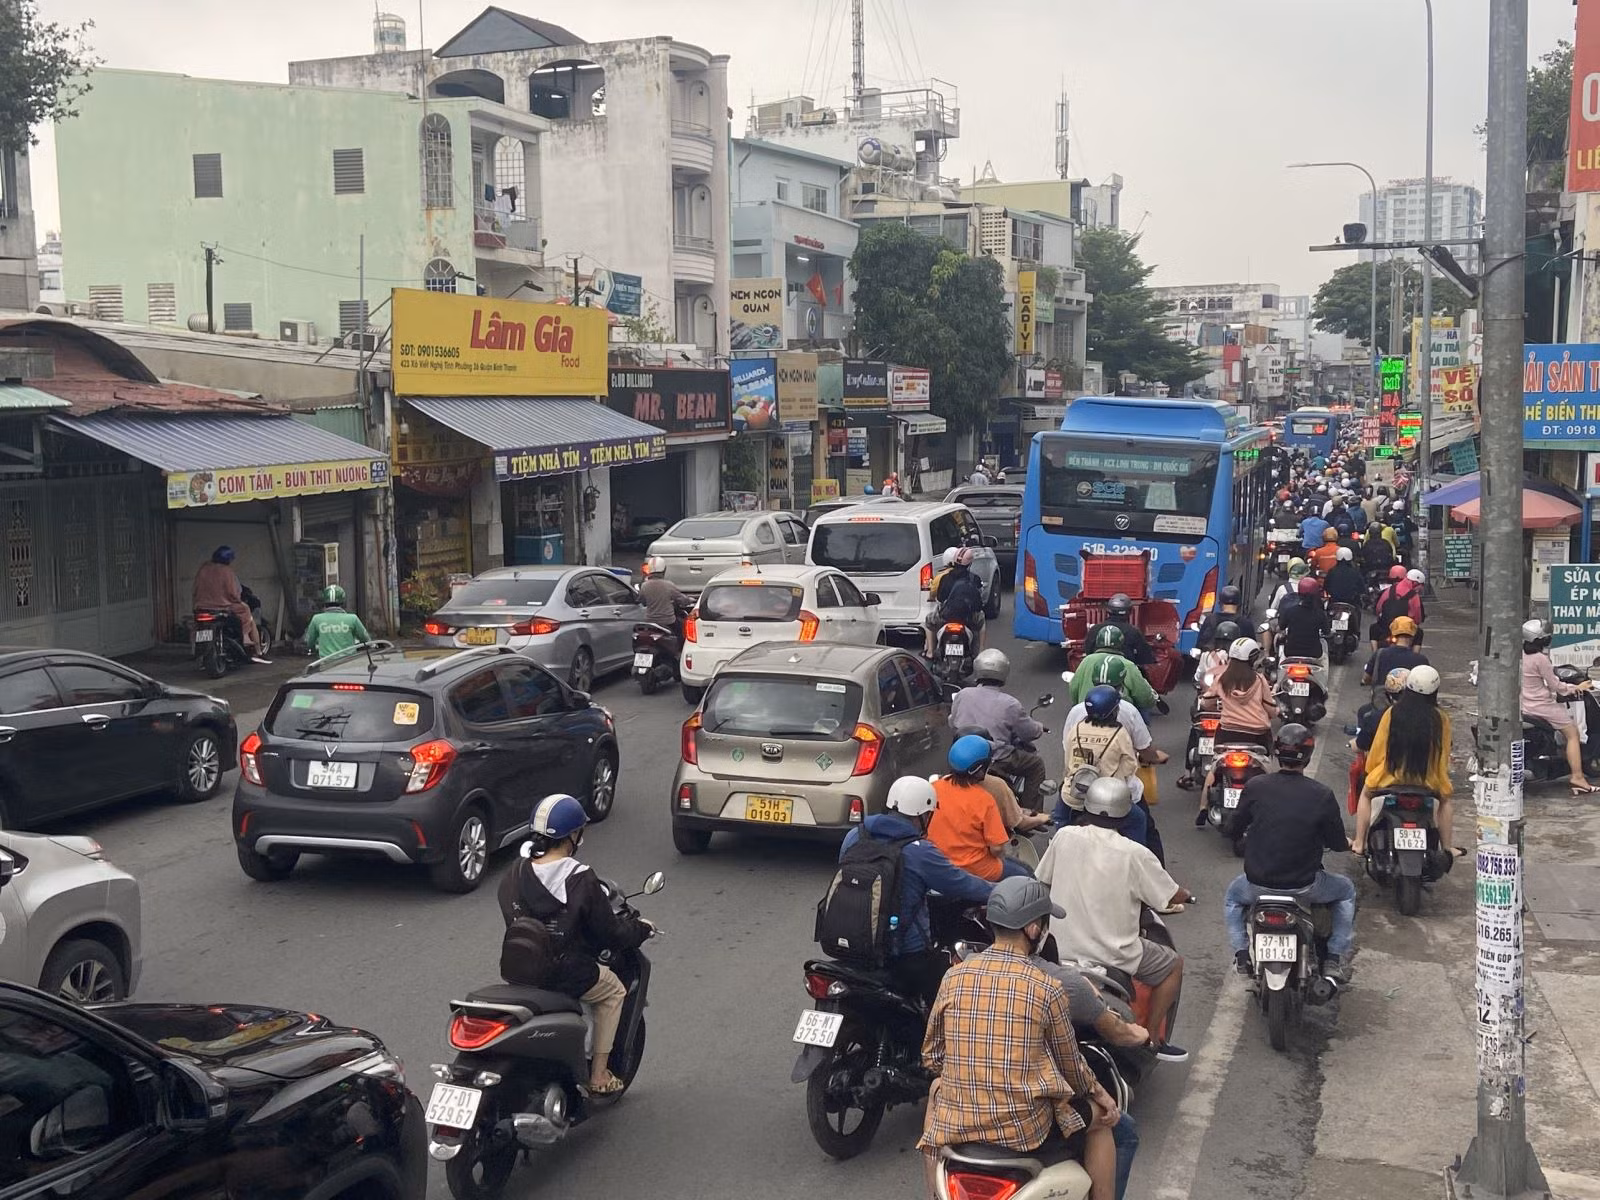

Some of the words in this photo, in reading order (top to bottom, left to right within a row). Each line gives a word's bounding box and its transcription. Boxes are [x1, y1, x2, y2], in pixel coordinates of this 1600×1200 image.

[1020, 295, 1031, 350] CADIVI
[470, 309, 526, 351] Lâm
[534, 315, 574, 353] Gia
[417, 345, 460, 358] 0901536605
[561, 354, 580, 368] Food
[1444, 366, 1473, 385] VÉ
[1523, 351, 1544, 393] ẢI
[1547, 351, 1586, 393] SẢN
[1444, 384, 1474, 403] SỐ
[676, 392, 717, 420] BEAN
[1523, 398, 1544, 420] HẾ
[1546, 398, 1576, 420] BIẾN
[1542, 425, 1562, 435] ĐT:
[1566, 425, 1597, 435] 0918
[512, 451, 537, 477] TIỆM
[539, 448, 561, 471] NHÀ
[563, 446, 580, 468] TÍM
[590, 443, 613, 467] TIỆM
[614, 440, 633, 461] NHÀ
[634, 438, 650, 458] TÍM
[248, 467, 273, 492] TẤM
[1564, 567, 1591, 583] SỬA
[1570, 586, 1589, 601] ÉP
[1553, 606, 1583, 618] THAY
[319, 621, 350, 633] Grab
[312, 774, 351, 786] 071.57
[759, 799, 780, 811] 51H
[750, 809, 787, 822] 019.03
[1399, 829, 1421, 839] 59-X2
[1262, 935, 1290, 947] 37-N1
[1259, 948, 1294, 960] 181.48
[796, 1026, 835, 1045] 375.50
[438, 1087, 473, 1109] 77-D1
[429, 1104, 473, 1126] 529.67
